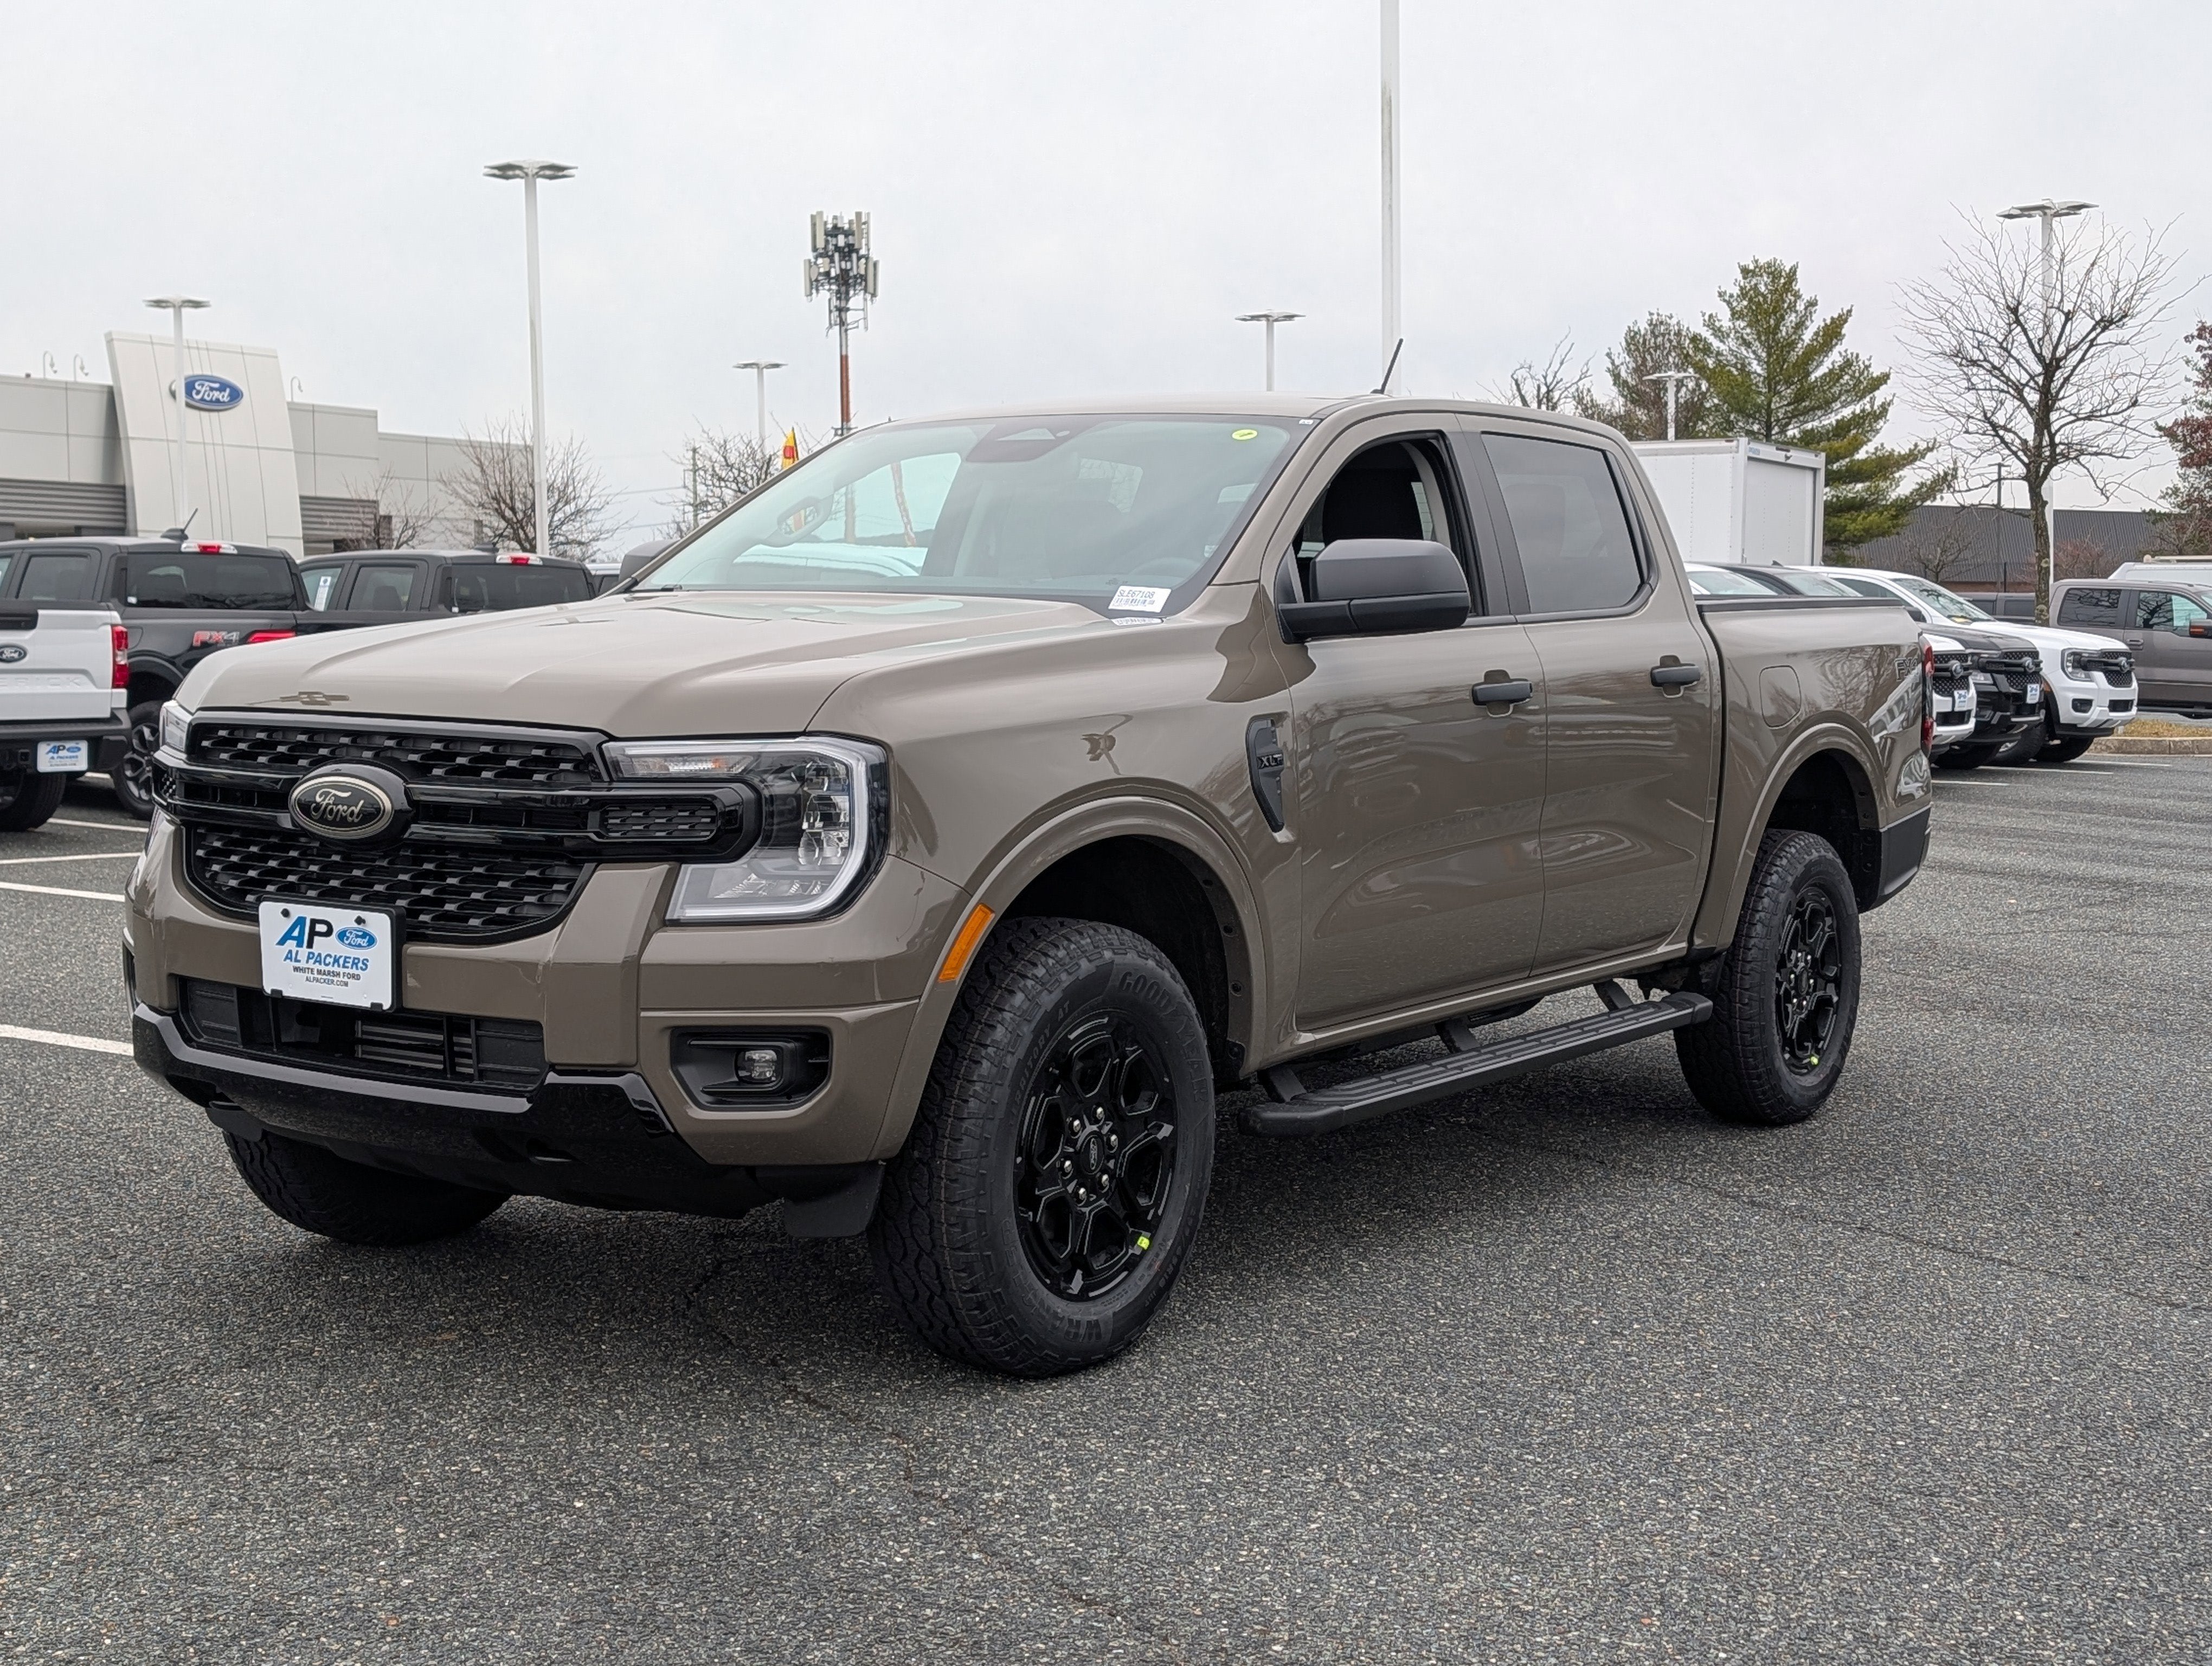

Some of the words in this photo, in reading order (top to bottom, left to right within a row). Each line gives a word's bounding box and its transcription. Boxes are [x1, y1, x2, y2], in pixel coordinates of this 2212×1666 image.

[192, 381, 230, 402] Ford
[193, 631, 240, 646] FX4
[1261, 753, 1283, 768] XLT
[311, 788, 364, 823] Ford
[275, 916, 333, 949] AP
[343, 930, 370, 947] Ford
[284, 949, 301, 963] AL
[306, 951, 369, 971] PACKERS
[293, 965, 315, 976] WHITE
[317, 968, 340, 978] MARSH
[343, 971, 361, 981] FORD
[305, 976, 349, 987] ALPACKER.COM
[1118, 971, 1209, 1103] GOODYEAR
[1001, 1217, 1102, 1343] WRANGLER
